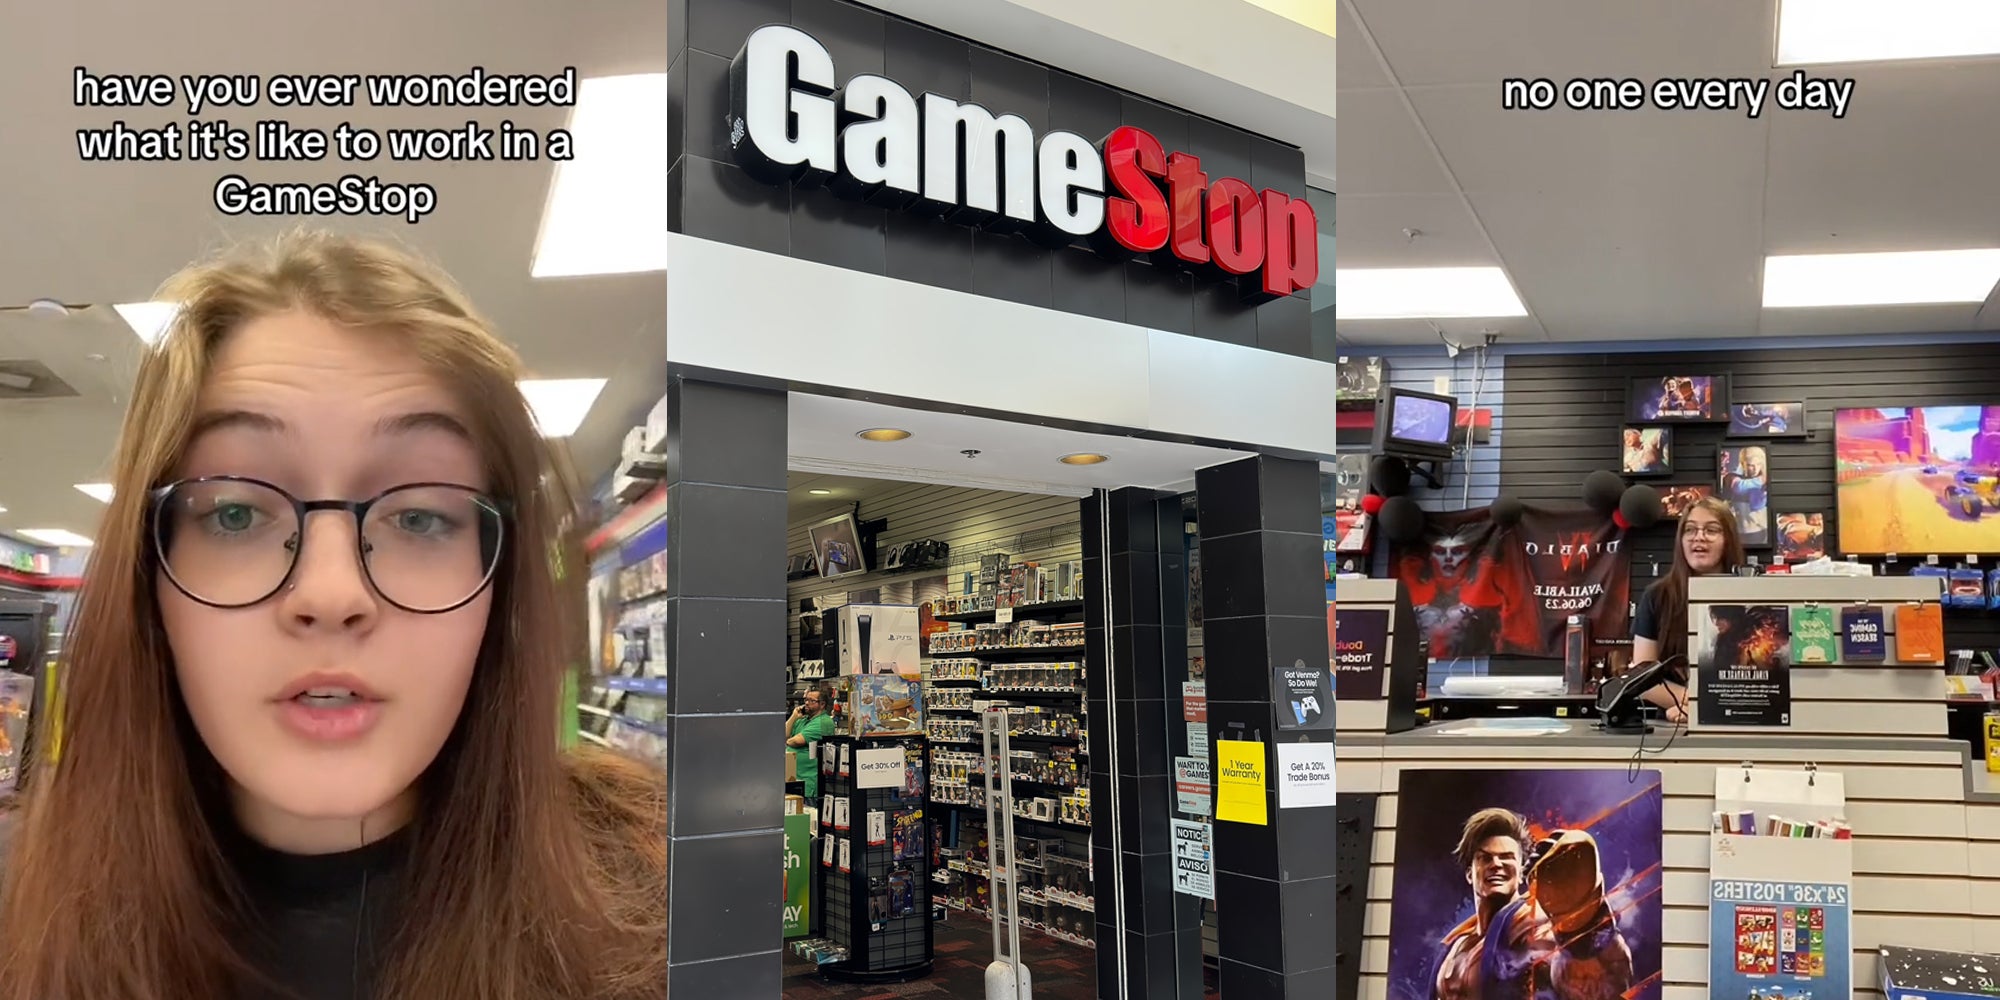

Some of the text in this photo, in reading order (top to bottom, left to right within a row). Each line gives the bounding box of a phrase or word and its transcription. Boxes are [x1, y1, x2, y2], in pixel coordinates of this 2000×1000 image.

[744, 22, 1320, 297] GameStop
[1296, 671, 1320, 679] Venmo?
[875, 762, 889, 770] 30%
[890, 761, 901, 769] Off
[1177, 761, 1194, 770] WANT
[1196, 762, 1205, 771] TO
[1230, 760, 1254, 770] 1 Year
[1290, 762, 1325, 771] Get A 20%
[1222, 768, 1261, 782] Warranty
[1287, 773, 1330, 782] Trade Bonus
[1177, 828, 1202, 840] NOTIC
[1179, 859, 1208, 872] AVISO
